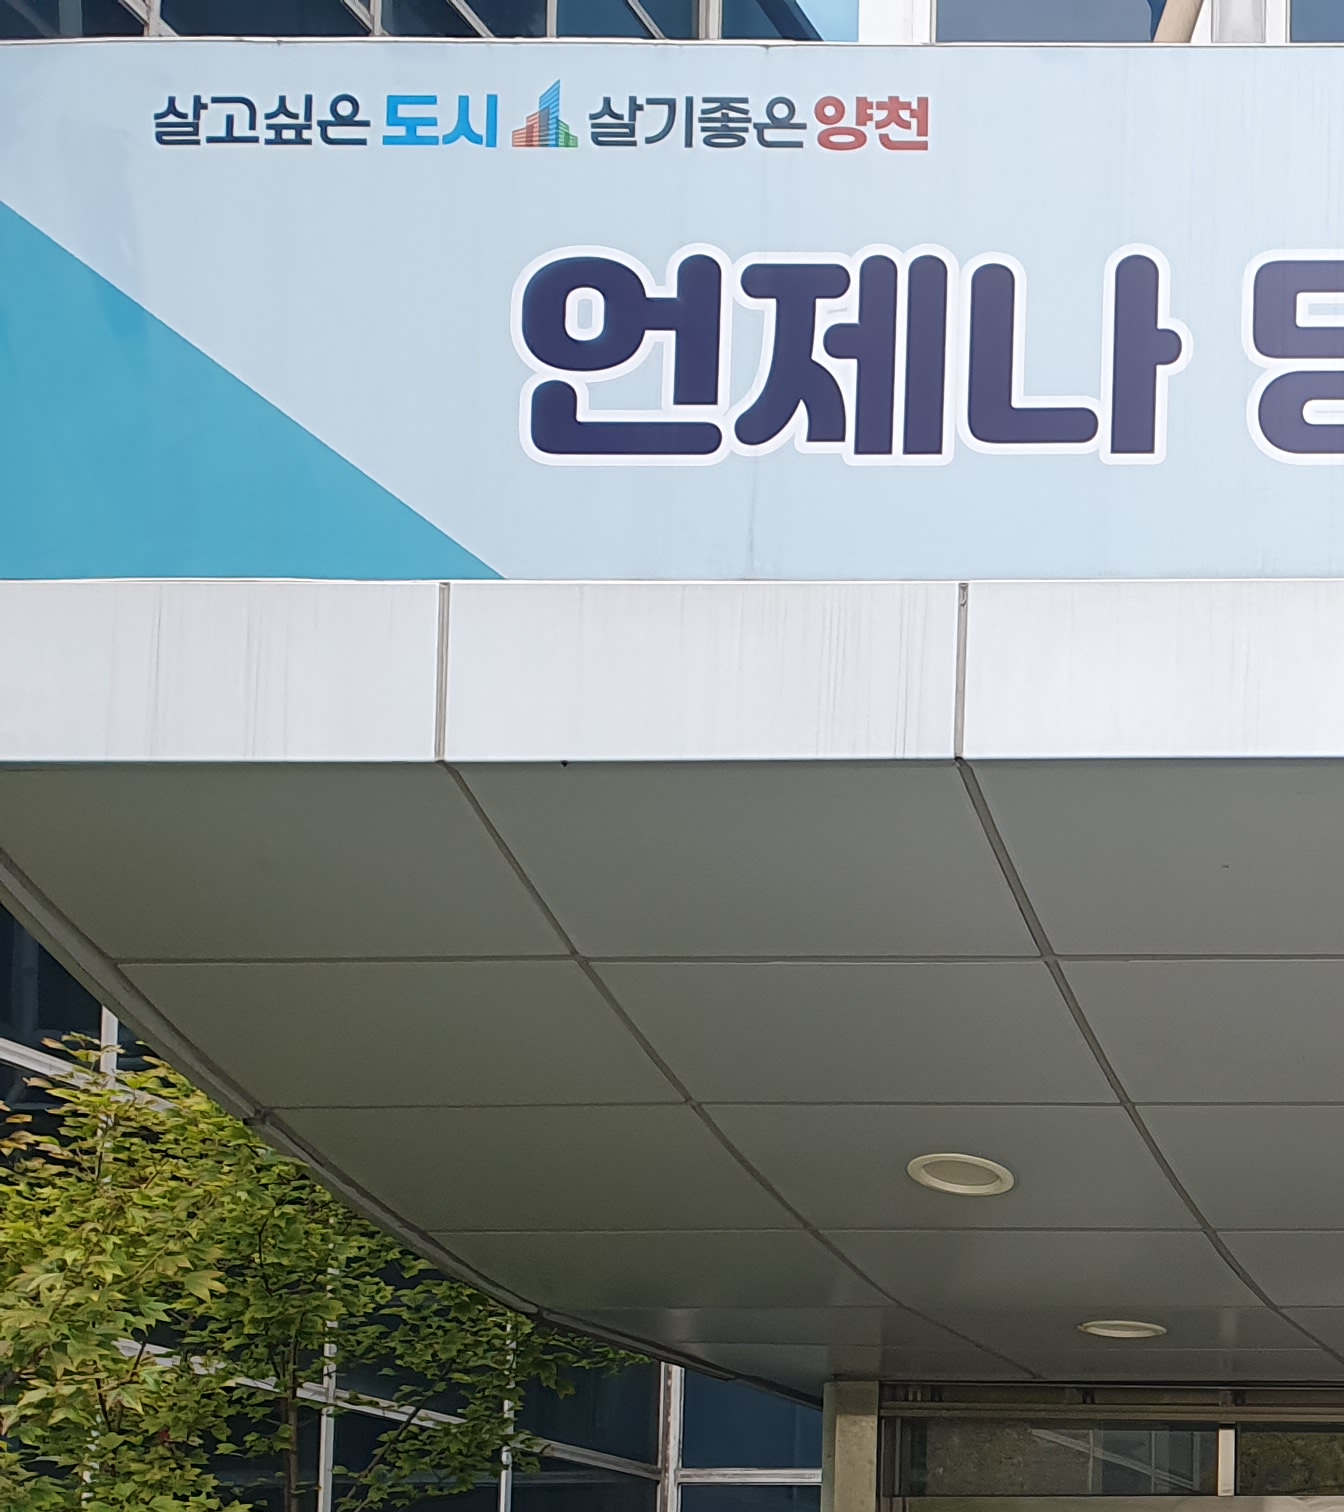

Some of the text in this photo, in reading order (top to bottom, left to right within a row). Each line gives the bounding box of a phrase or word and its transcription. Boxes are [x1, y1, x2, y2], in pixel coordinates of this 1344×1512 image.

[153, 92, 931, 152] 살고싶은 도시 살기좋은 양천
[518, 250, 1184, 458] 언제나
